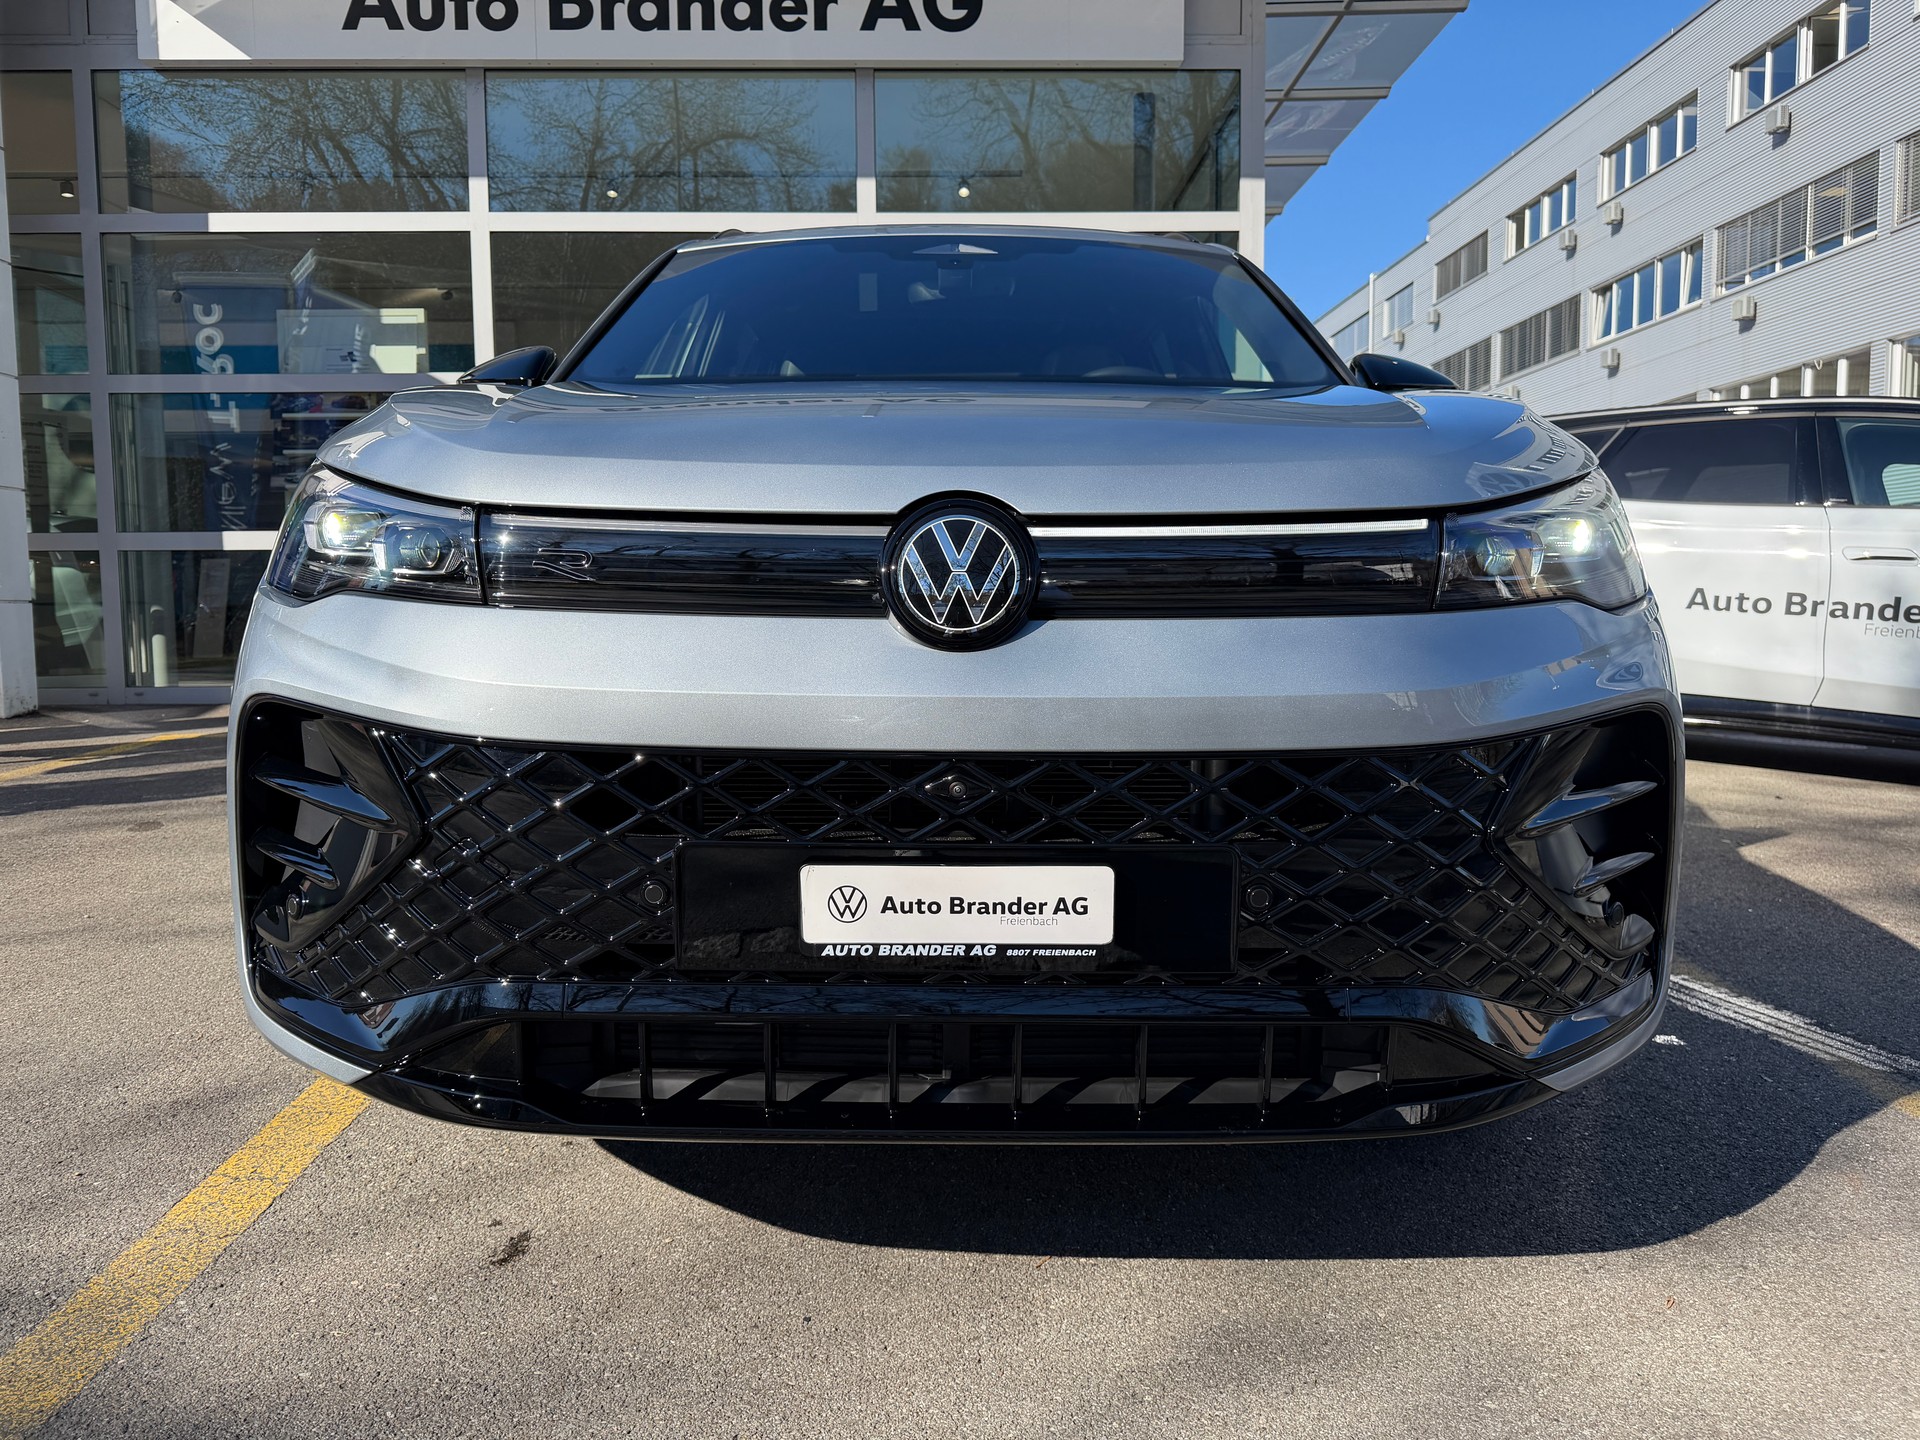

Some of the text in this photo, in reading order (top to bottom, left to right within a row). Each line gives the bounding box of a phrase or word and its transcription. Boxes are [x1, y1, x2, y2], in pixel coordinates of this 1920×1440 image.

[342, 0, 519, 32] Auto
[859, 0, 984, 32] AG
[1685, 587, 1773, 615] Auto
[880, 896, 1089, 915] Auto Brander AG
[1000, 916, 1059, 926] Freienbach
[821, 944, 874, 956] AUTO
[878, 944, 966, 956] BRANDER
[969, 944, 997, 956] AG
[1032, 949, 1097, 957] FREIENBACH
